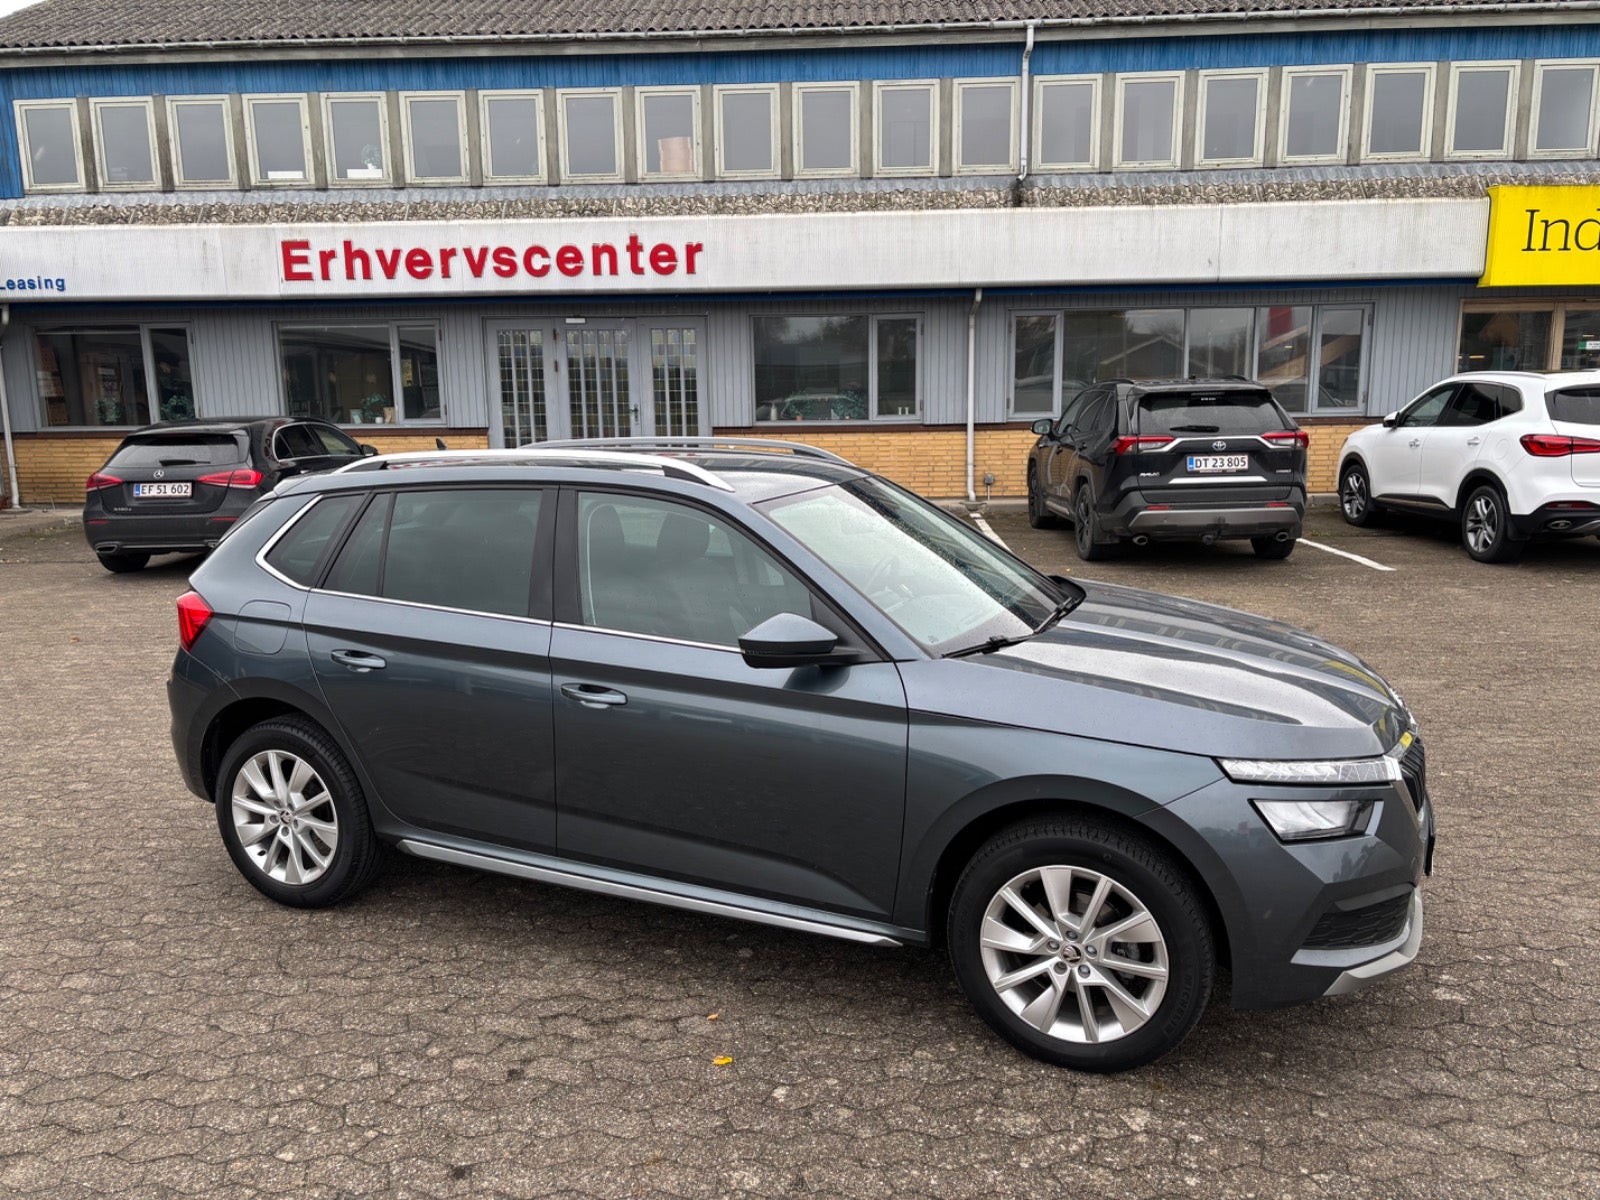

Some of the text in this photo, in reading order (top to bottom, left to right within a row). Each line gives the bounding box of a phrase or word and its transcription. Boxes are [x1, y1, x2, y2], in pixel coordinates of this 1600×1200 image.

[281, 233, 703, 282] Erhvervscenter
[1195, 456, 1247, 469] DT 23 805
[141, 484, 189, 495] EF 51 602
